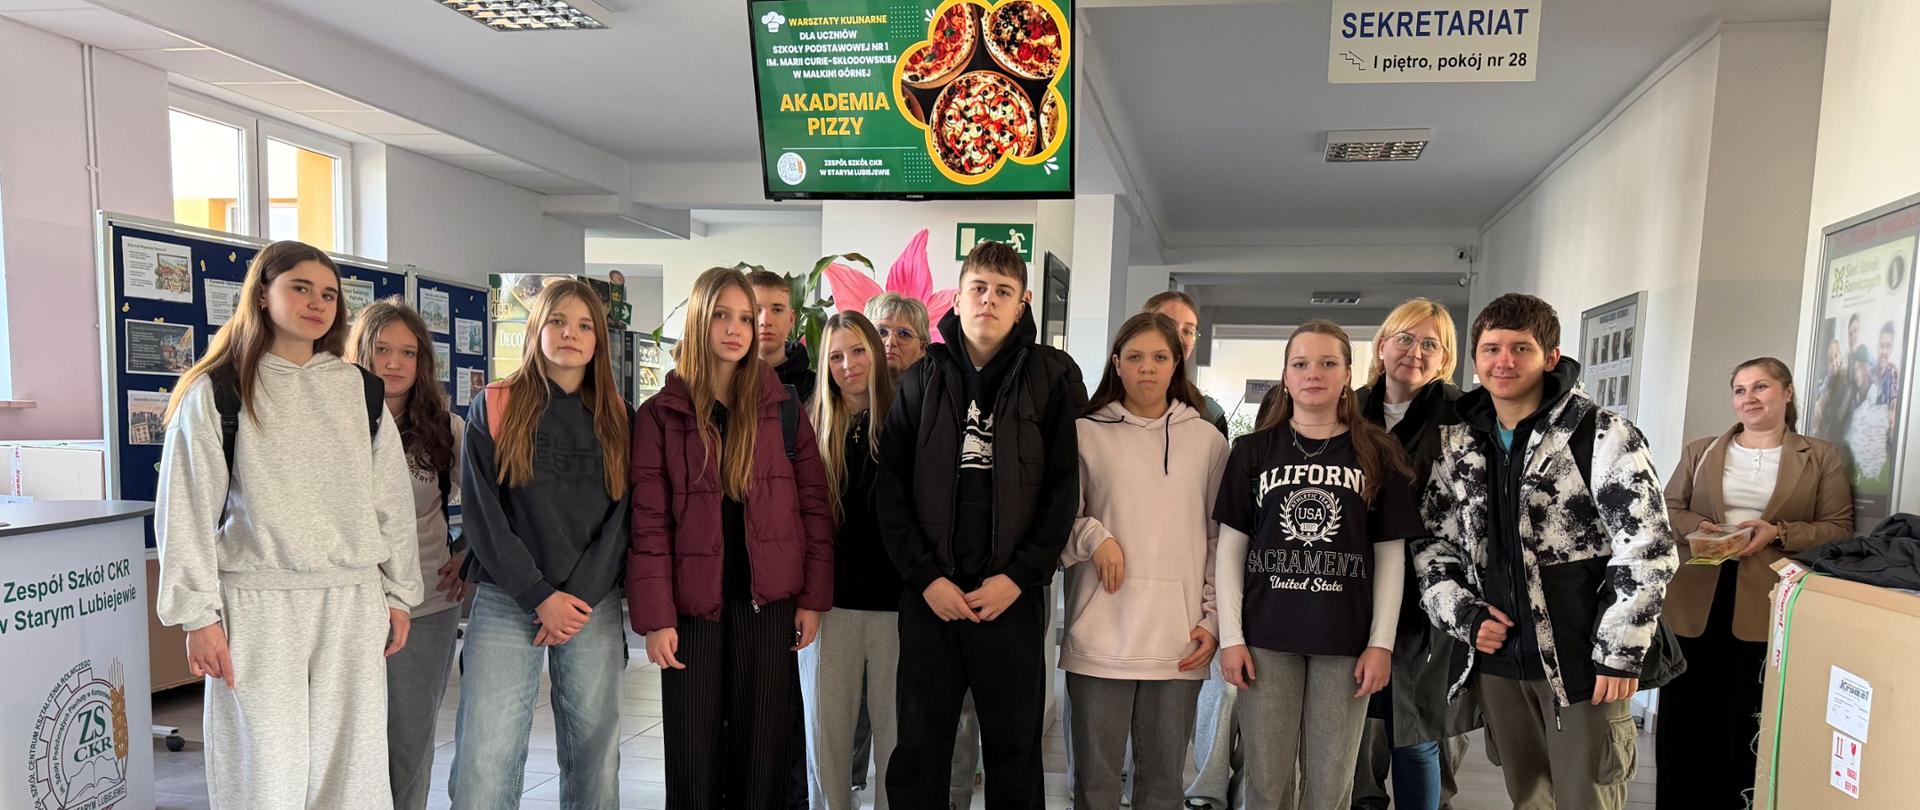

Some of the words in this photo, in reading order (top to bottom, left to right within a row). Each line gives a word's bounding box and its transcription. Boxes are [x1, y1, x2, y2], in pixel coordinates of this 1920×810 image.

[788, 16, 839, 27] WARSZTATY
[840, 14, 888, 25] KULINARNE
[1341, 8, 1529, 39] SEKRETARIAT
[799, 31, 816, 41] DLA
[816, 28, 858, 40] UCZNIÓW
[772, 44, 804, 54] SZKOŁY
[804, 43, 871, 53] PODSTAWOWEJ
[871, 42, 884, 51] NR
[884, 42, 889, 51] 1
[766, 58, 779, 67] IM.
[780, 57, 804, 67] MARII
[804, 54, 897, 66] CURIE-SKŁODOWSKIEJ
[1373, 55, 1378, 69] I
[1382, 54, 1433, 72] piętro,
[1437, 52, 1482, 71] pokój
[1487, 54, 1504, 68] nr
[1508, 52, 1527, 67] 28
[793, 70, 802, 79] W
[803, 69, 837, 79] MAŁKINI
[837, 67, 871, 78] GÓRNEJ
[780, 92, 890, 112] AKADEMIA
[807, 117, 864, 136] PIZZY
[824, 158, 847, 167] ZESPÓŁ
[847, 158, 868, 167] SZKÓŁ
[1291, 493, 1317, 509] ATHLETIC
[1318, 495, 1331, 510] TEAM
[1298, 507, 1323, 520] USA
[1248, 549, 1367, 578] SACRAMENT
[4, 573, 64, 604] Zespół
[68, 563, 105, 591] Szkół
[107, 558, 131, 581] CKR
[1270, 574, 1310, 590] United
[14, 603, 75, 632] Starym
[79, 583, 137, 618] Lubiejewie
[77, 705, 106, 746] ZS
[28, 731, 39, 771] CENTRUM
[73, 736, 113, 763] CKR
